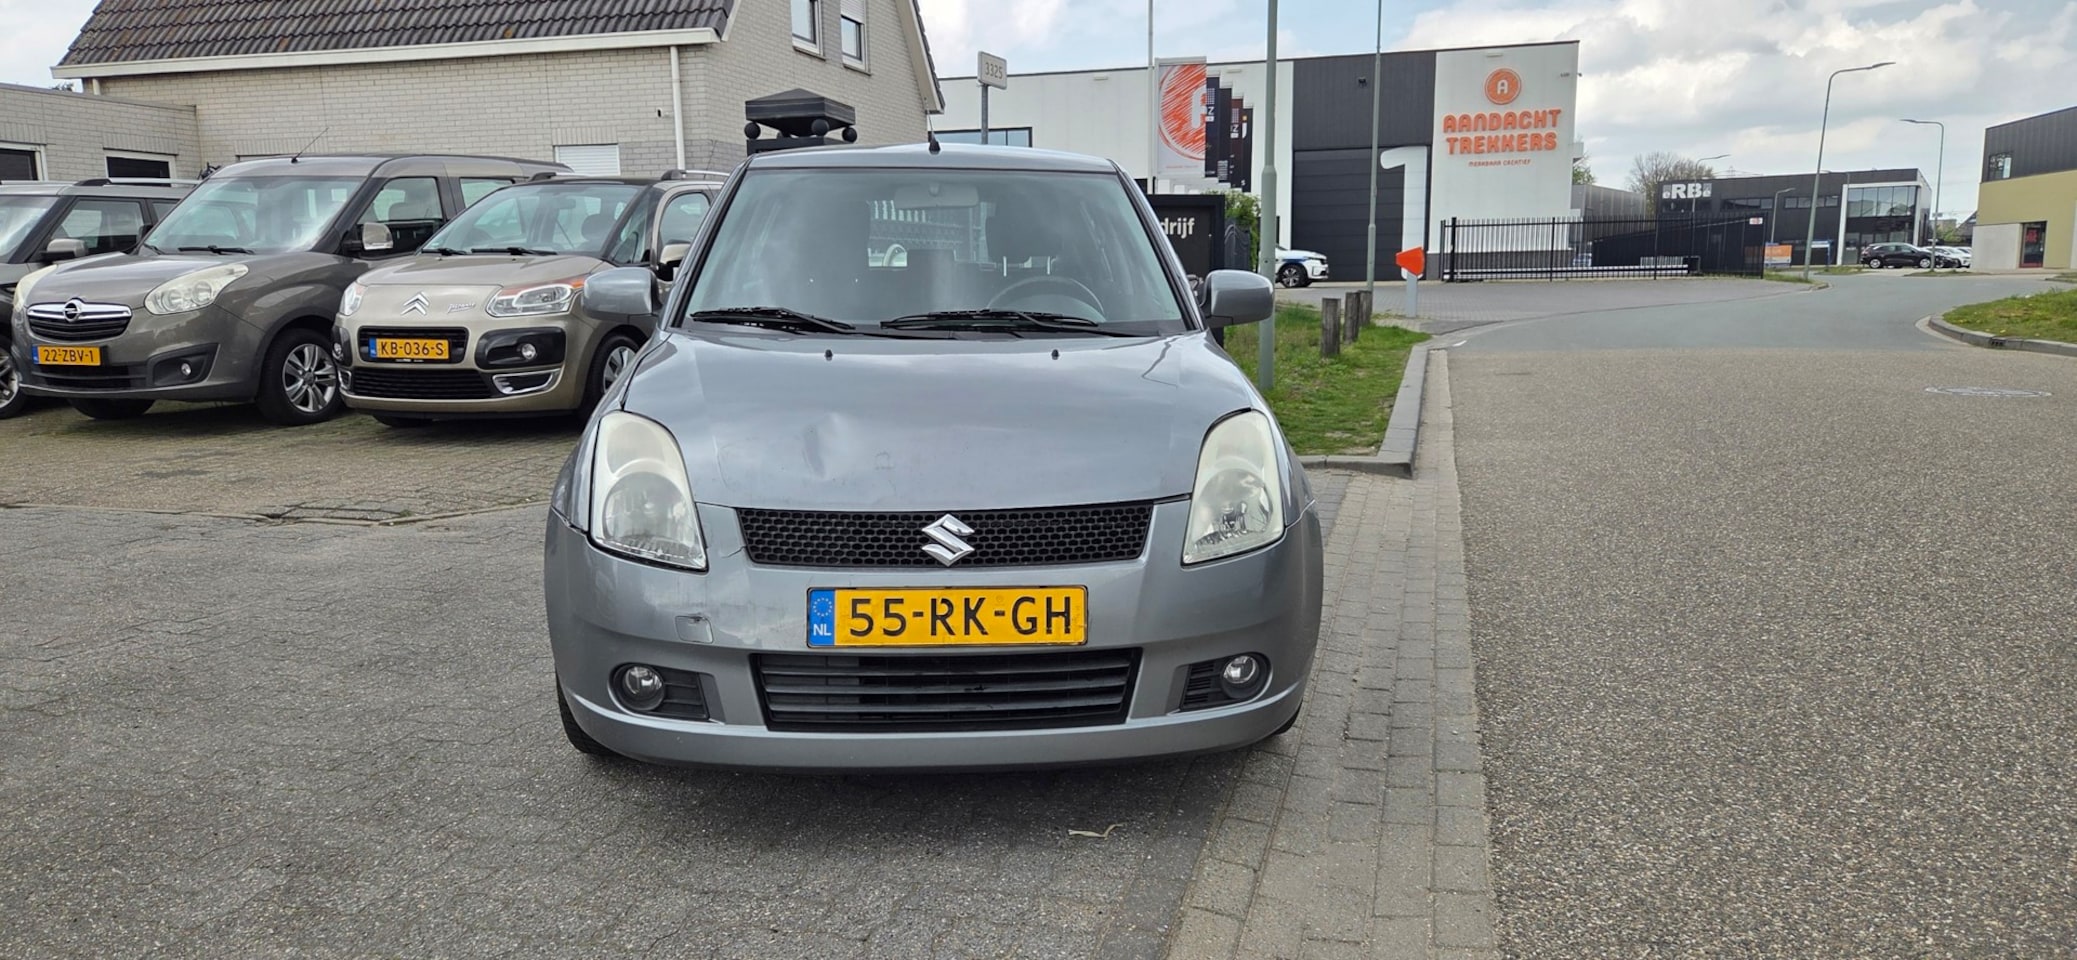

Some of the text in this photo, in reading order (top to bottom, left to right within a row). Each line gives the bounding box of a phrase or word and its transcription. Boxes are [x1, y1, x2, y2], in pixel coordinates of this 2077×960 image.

[985, 61, 1003, 80] 3325
[1497, 79, 1508, 95] A
[1443, 109, 1561, 133] AANDACHT
[1446, 132, 1557, 155] TREKKERS
[43, 348, 94, 362] 22-ZBV-1
[380, 341, 444, 356] KB-036-S
[813, 596, 1071, 637] NL 55-RK-GH
